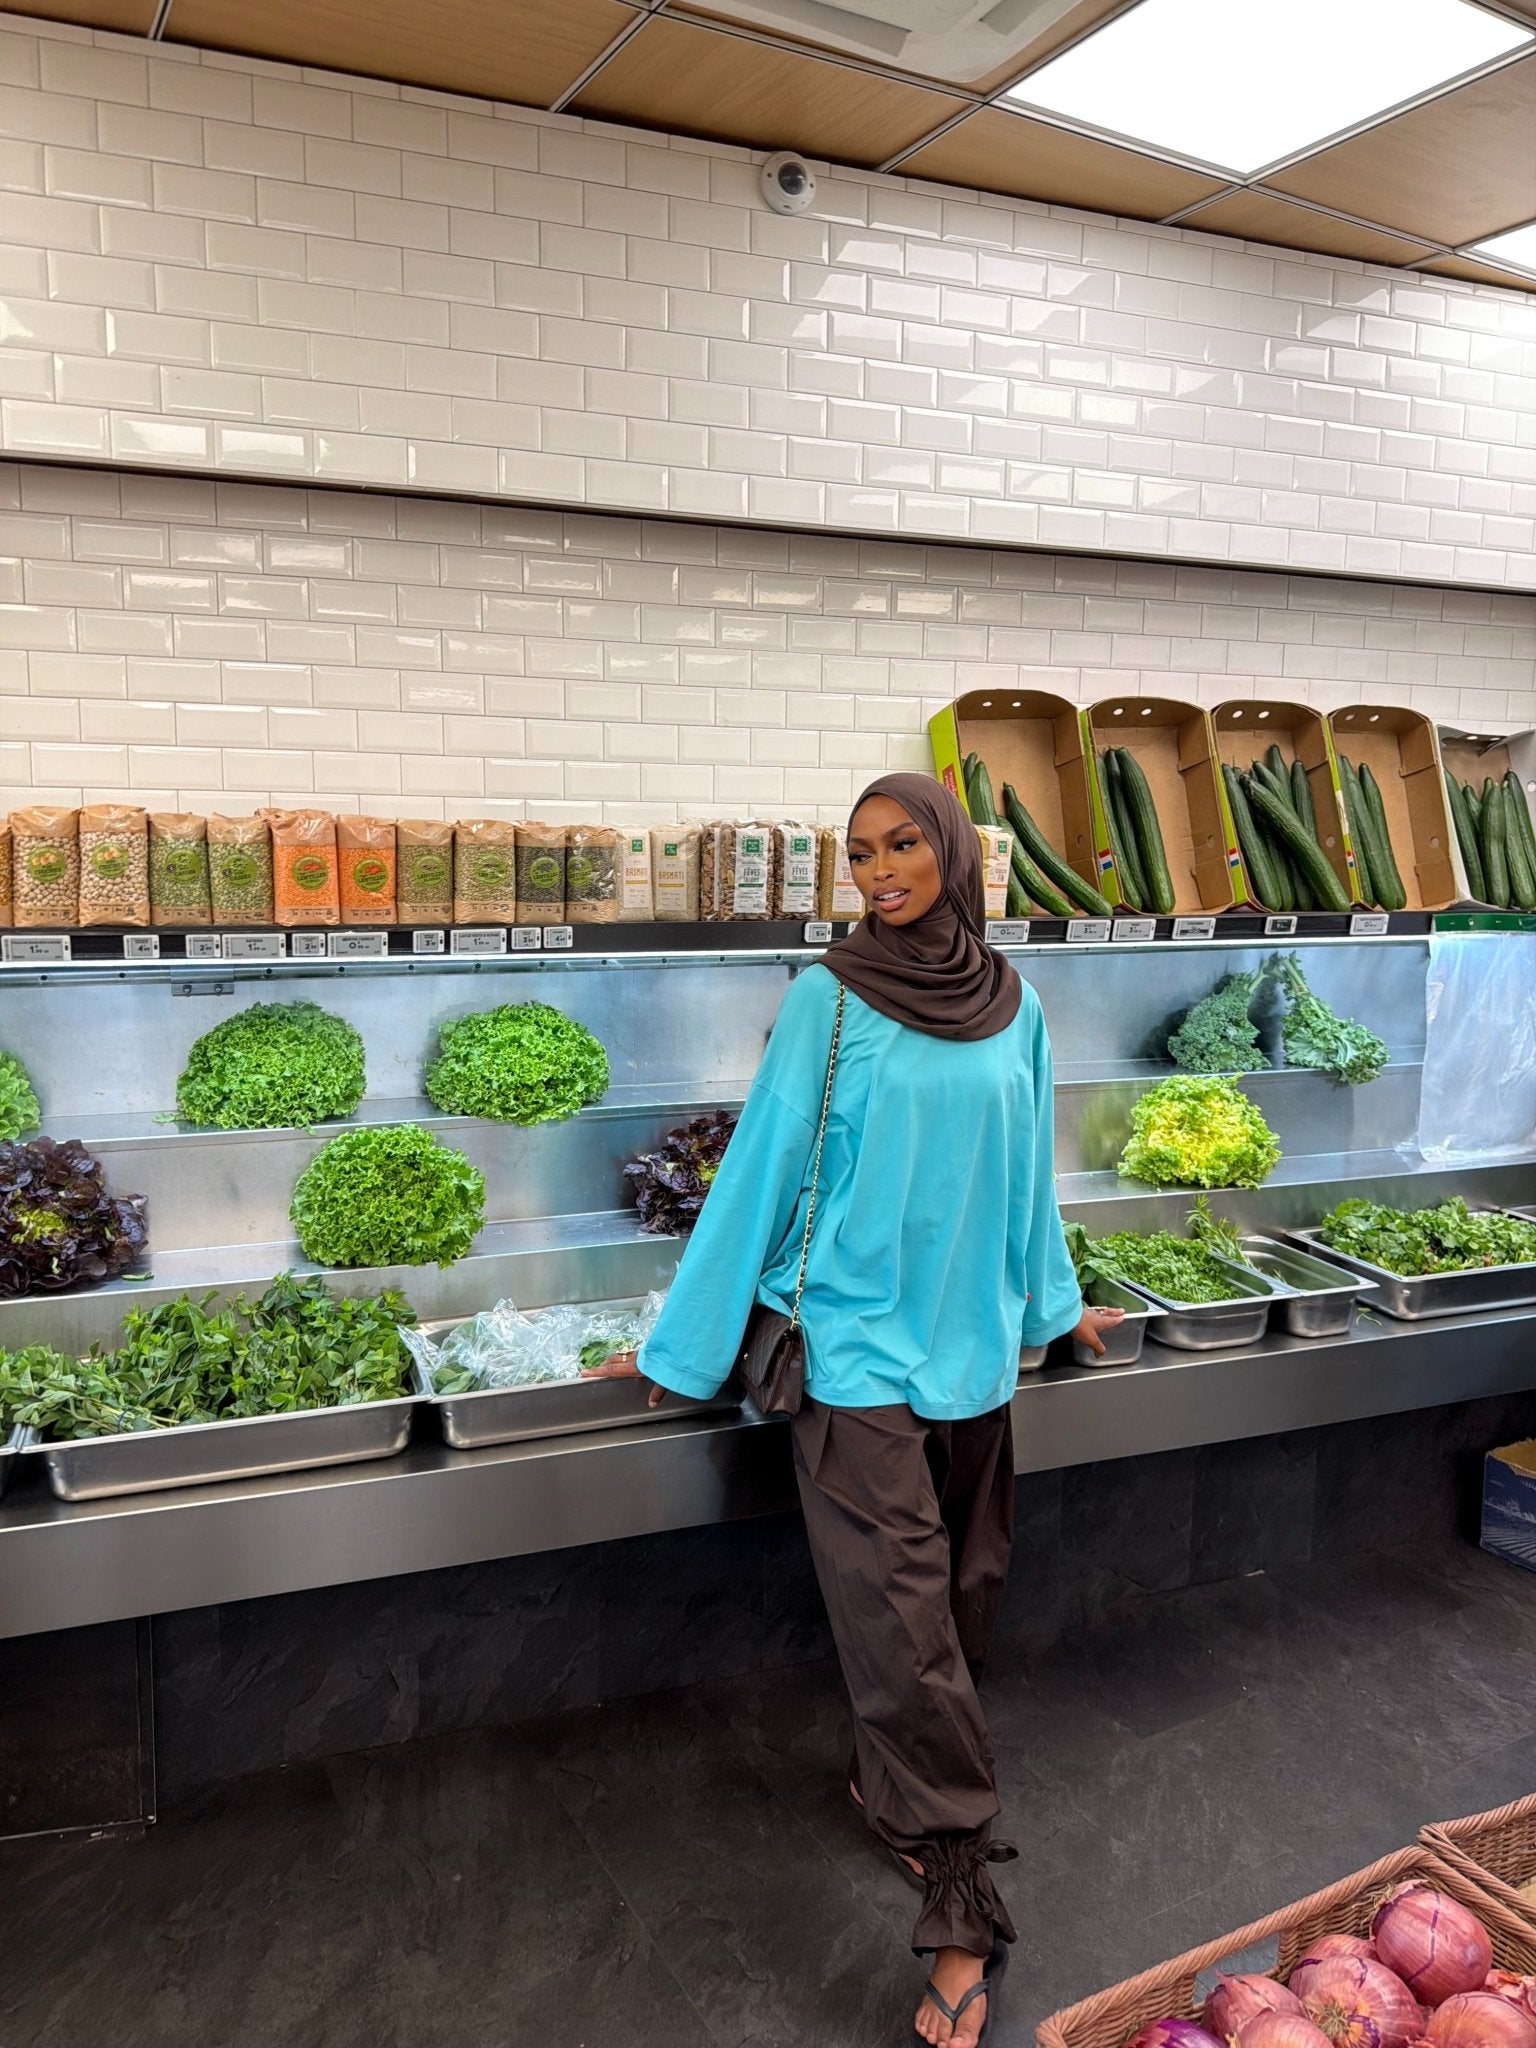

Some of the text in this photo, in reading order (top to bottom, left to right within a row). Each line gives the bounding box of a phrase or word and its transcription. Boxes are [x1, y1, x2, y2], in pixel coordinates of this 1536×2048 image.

[296, 872, 326, 881] LENTILLES
[625, 867, 648, 877] BASMATI
[658, 871, 685, 880] BASMATI
[358, 875, 386, 883] LENTILLES
